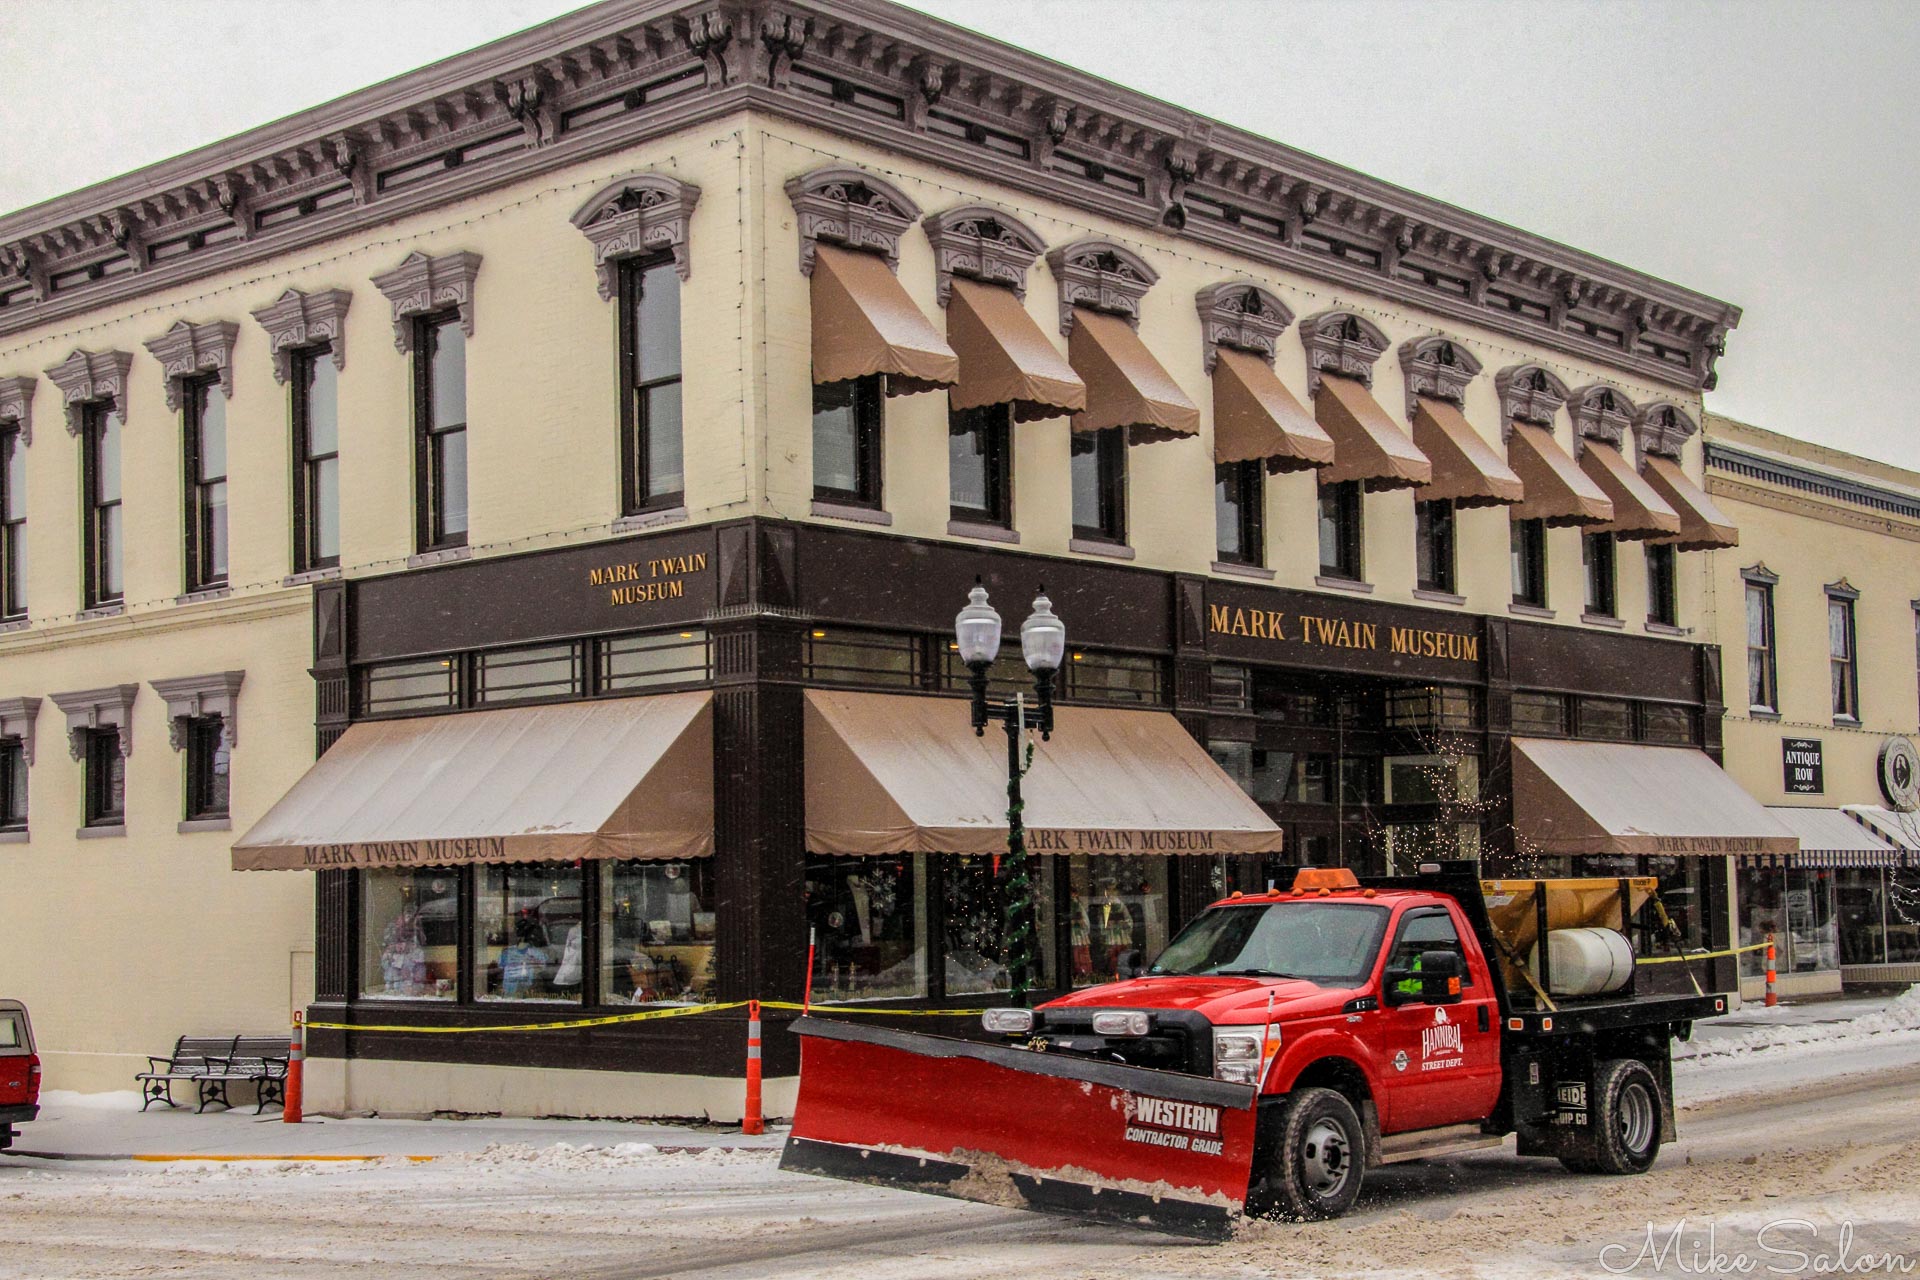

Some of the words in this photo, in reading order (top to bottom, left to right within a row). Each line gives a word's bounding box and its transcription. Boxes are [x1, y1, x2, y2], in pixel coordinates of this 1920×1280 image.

[590, 562, 640, 586] MARK
[649, 553, 707, 578] TWAIN
[611, 580, 684, 606] MUSEUM
[1209, 604, 1285, 641] MARK
[1300, 615, 1377, 650] TWAIN
[1391, 626, 1479, 662] MUSEUM
[1785, 750, 1820, 767] ANTIQUE
[1795, 768, 1814, 781] ROW
[303, 843, 357, 865] MARK
[360, 841, 419, 863] TWAIN
[426, 837, 506, 860] MUSEUM
[1027, 830, 1068, 850] ARK
[1074, 830, 1133, 850] TWAIN
[1140, 831, 1214, 850] MUSEUM
[1656, 837, 1688, 851] MARK
[1690, 837, 1721, 851] TWAIN
[1725, 838, 1764, 851] MUSEUM
[1422, 1024, 1463, 1059] HANNIBAL
[1422, 1060, 1445, 1071] STREET
[1446, 1058, 1463, 1068] DEPT.
[1137, 1097, 1219, 1133] WESTERN
[1125, 1127, 1189, 1150] CONTRACTOR
[1191, 1139, 1224, 1156] GRADE
